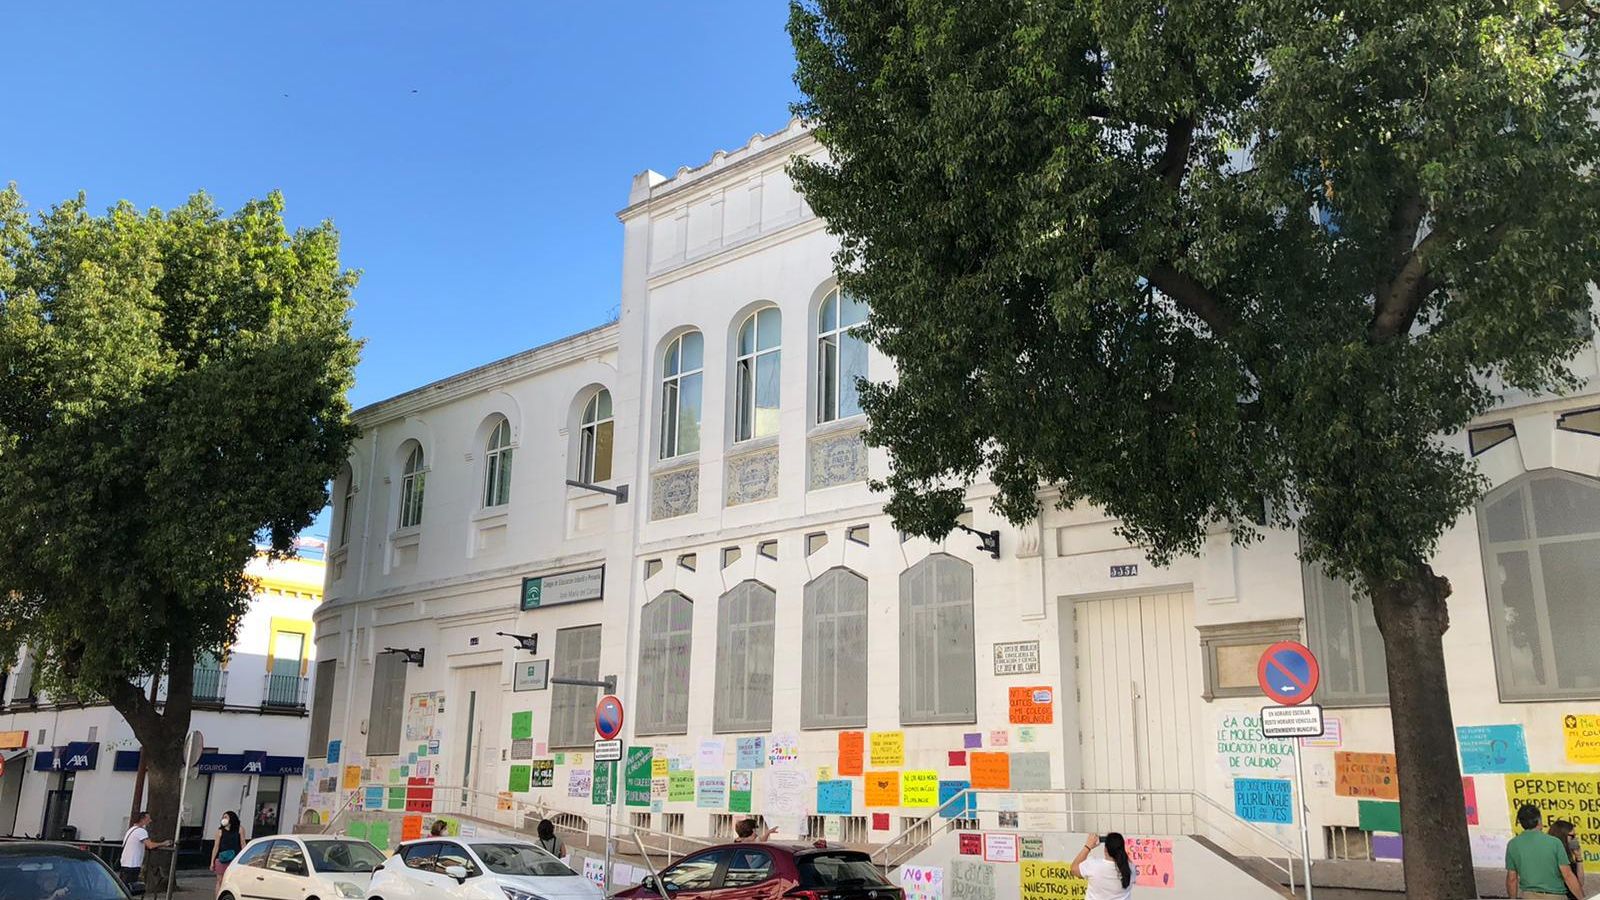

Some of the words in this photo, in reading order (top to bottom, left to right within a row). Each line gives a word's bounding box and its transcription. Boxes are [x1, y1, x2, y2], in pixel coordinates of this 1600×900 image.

[66, 755, 88, 766] AXA
[1230, 757, 1240, 767] DE
[242, 762, 262, 772] AXA
[1514, 779, 1592, 794] PERDEMOS
[904, 869, 921, 881] NO
[1024, 882, 1068, 895] NUESTROS
